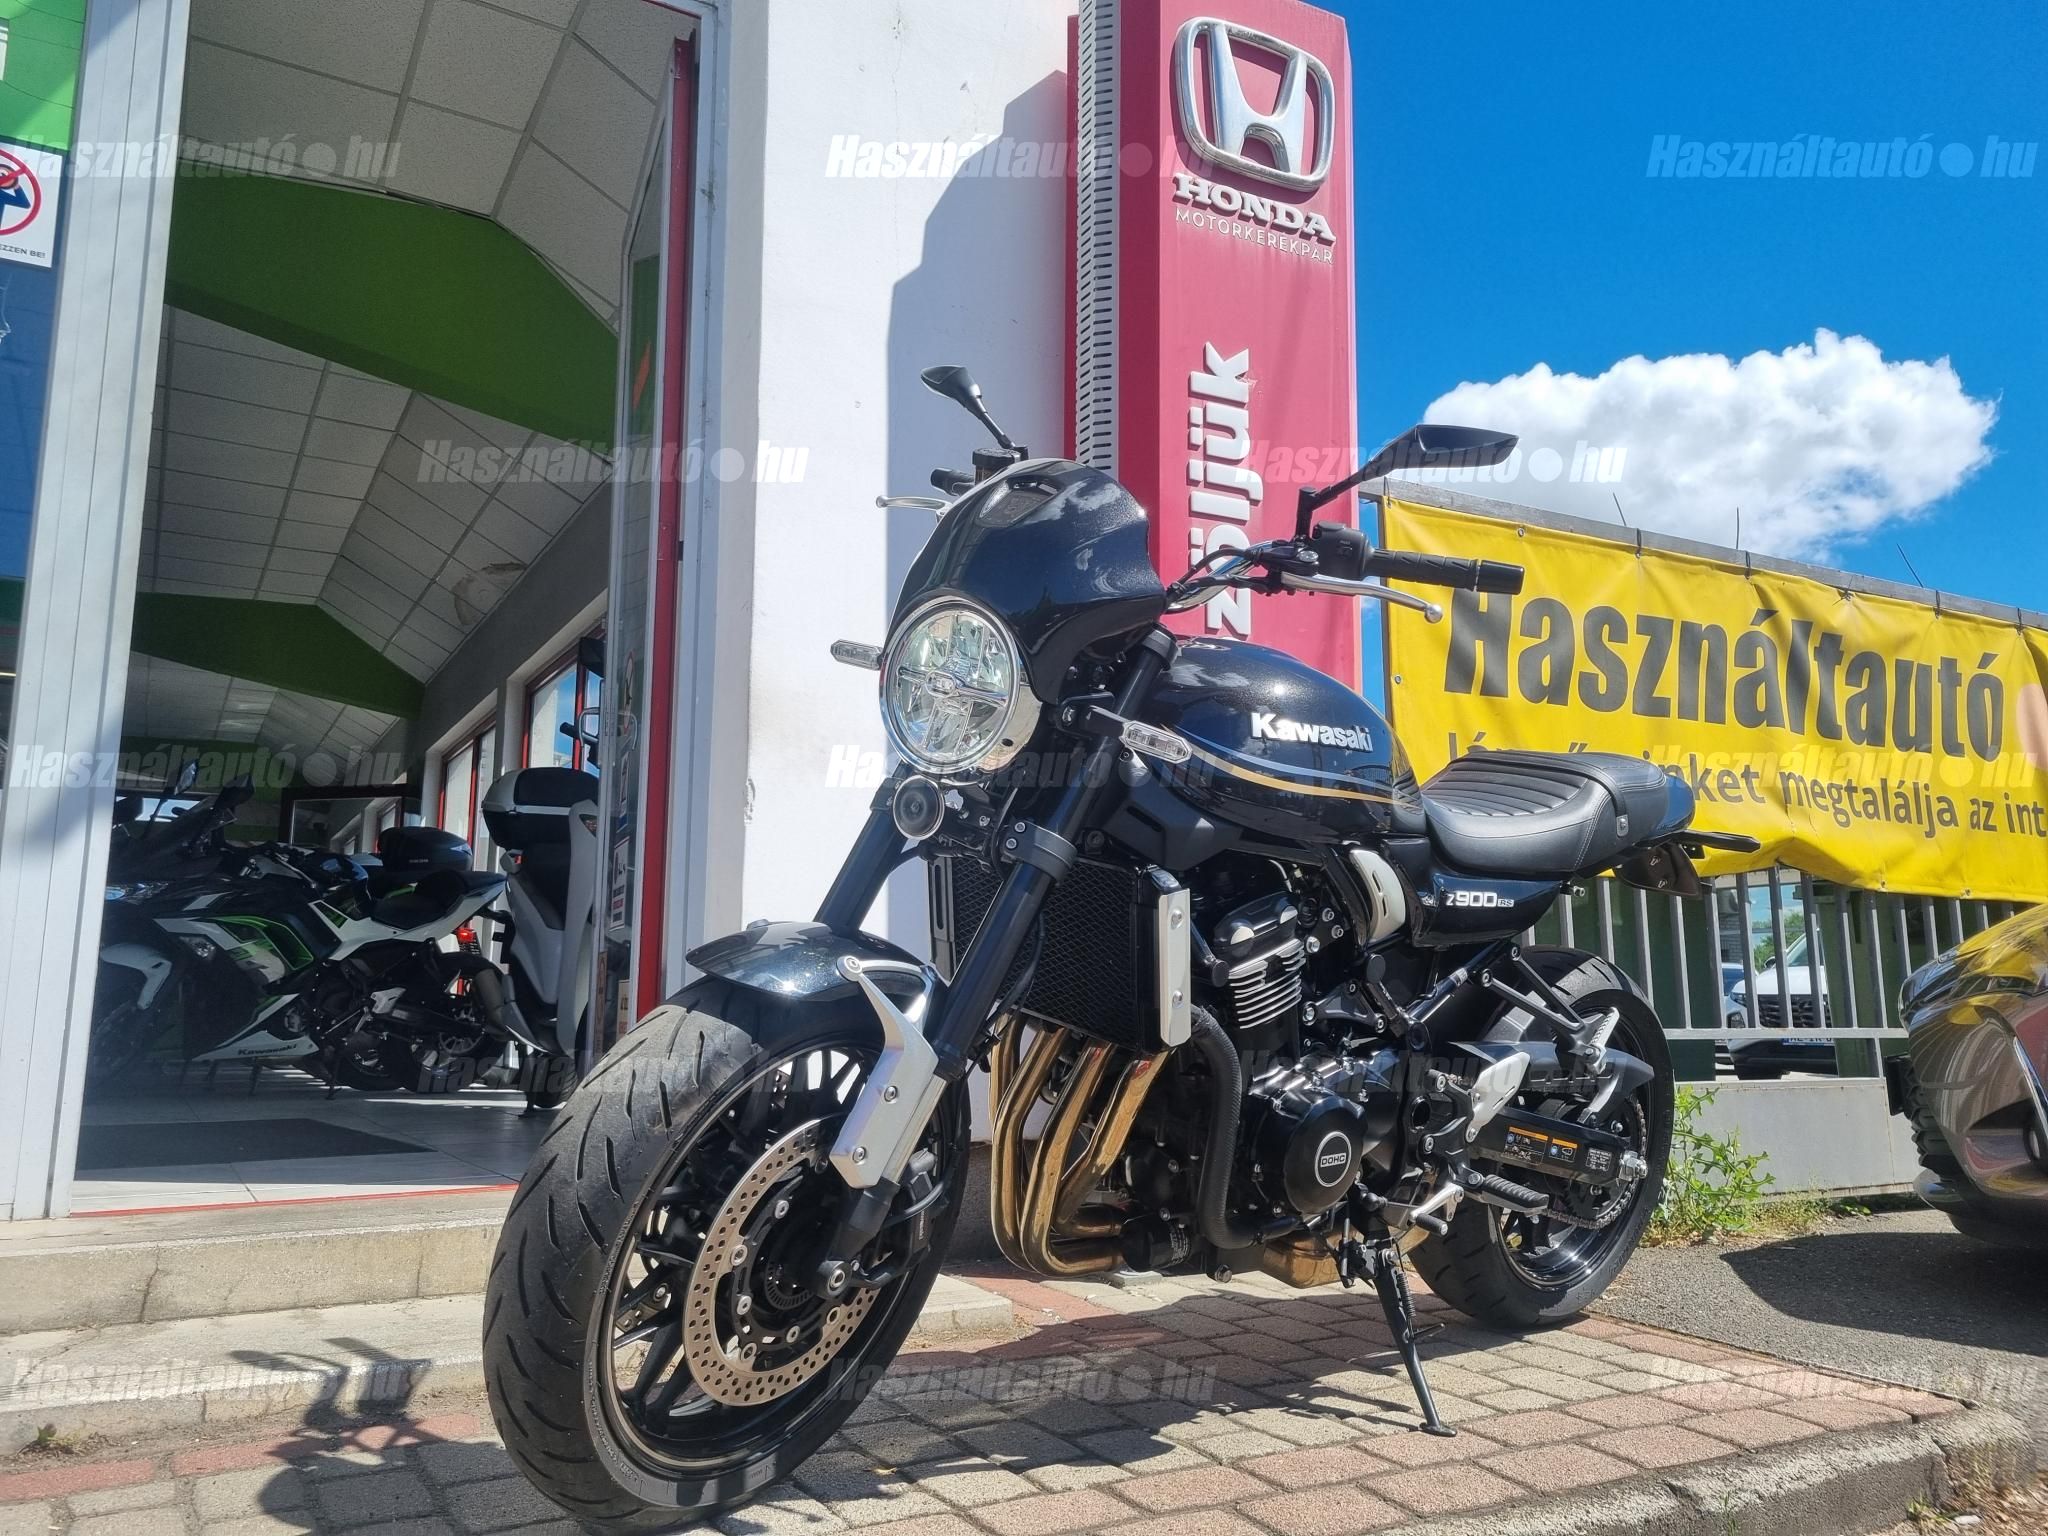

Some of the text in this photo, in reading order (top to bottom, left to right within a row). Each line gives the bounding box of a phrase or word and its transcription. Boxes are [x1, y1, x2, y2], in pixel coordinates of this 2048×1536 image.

[1172, 172, 1337, 243] HONDA
[1443, 587, 2006, 763] Használtautó
[1250, 711, 1374, 752] Kawasaki
[1780, 770, 1961, 840] megtalálja
[1969, 797, 1999, 832] az
[1320, 1152, 1347, 1168] DOHC
